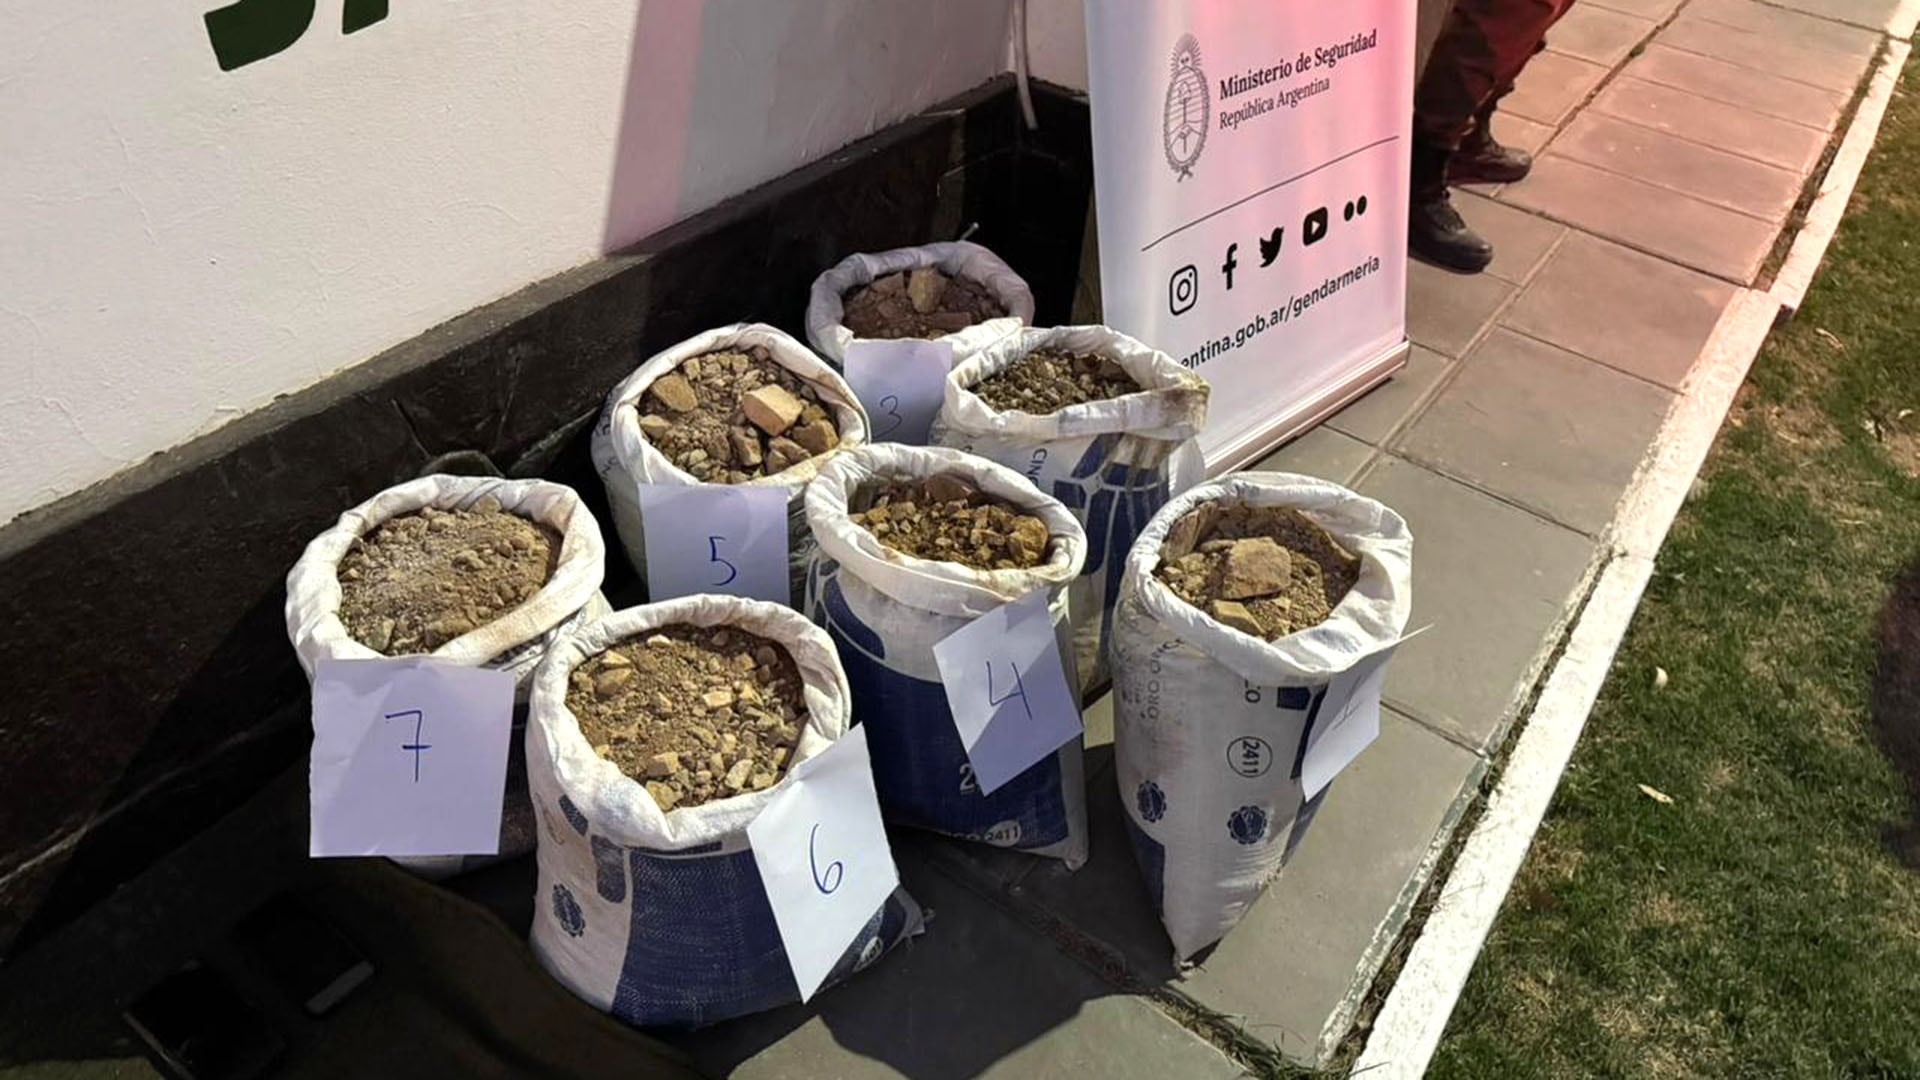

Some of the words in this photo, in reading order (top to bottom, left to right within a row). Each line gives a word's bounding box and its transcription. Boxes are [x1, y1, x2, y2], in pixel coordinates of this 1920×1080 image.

[1219, 58, 1292, 101] Ministerio
[1295, 52, 1312, 73] de
[1315, 28, 1378, 68] Seguridad
[1219, 98, 1274, 130] República
[1276, 76, 1331, 108] Argentina
[873, 394, 903, 438] 3
[709, 535, 738, 588] 5
[986, 660, 1032, 721] 4
[385, 708, 432, 783] 7
[1242, 739, 1261, 775] 2411
[808, 823, 844, 895] 6
